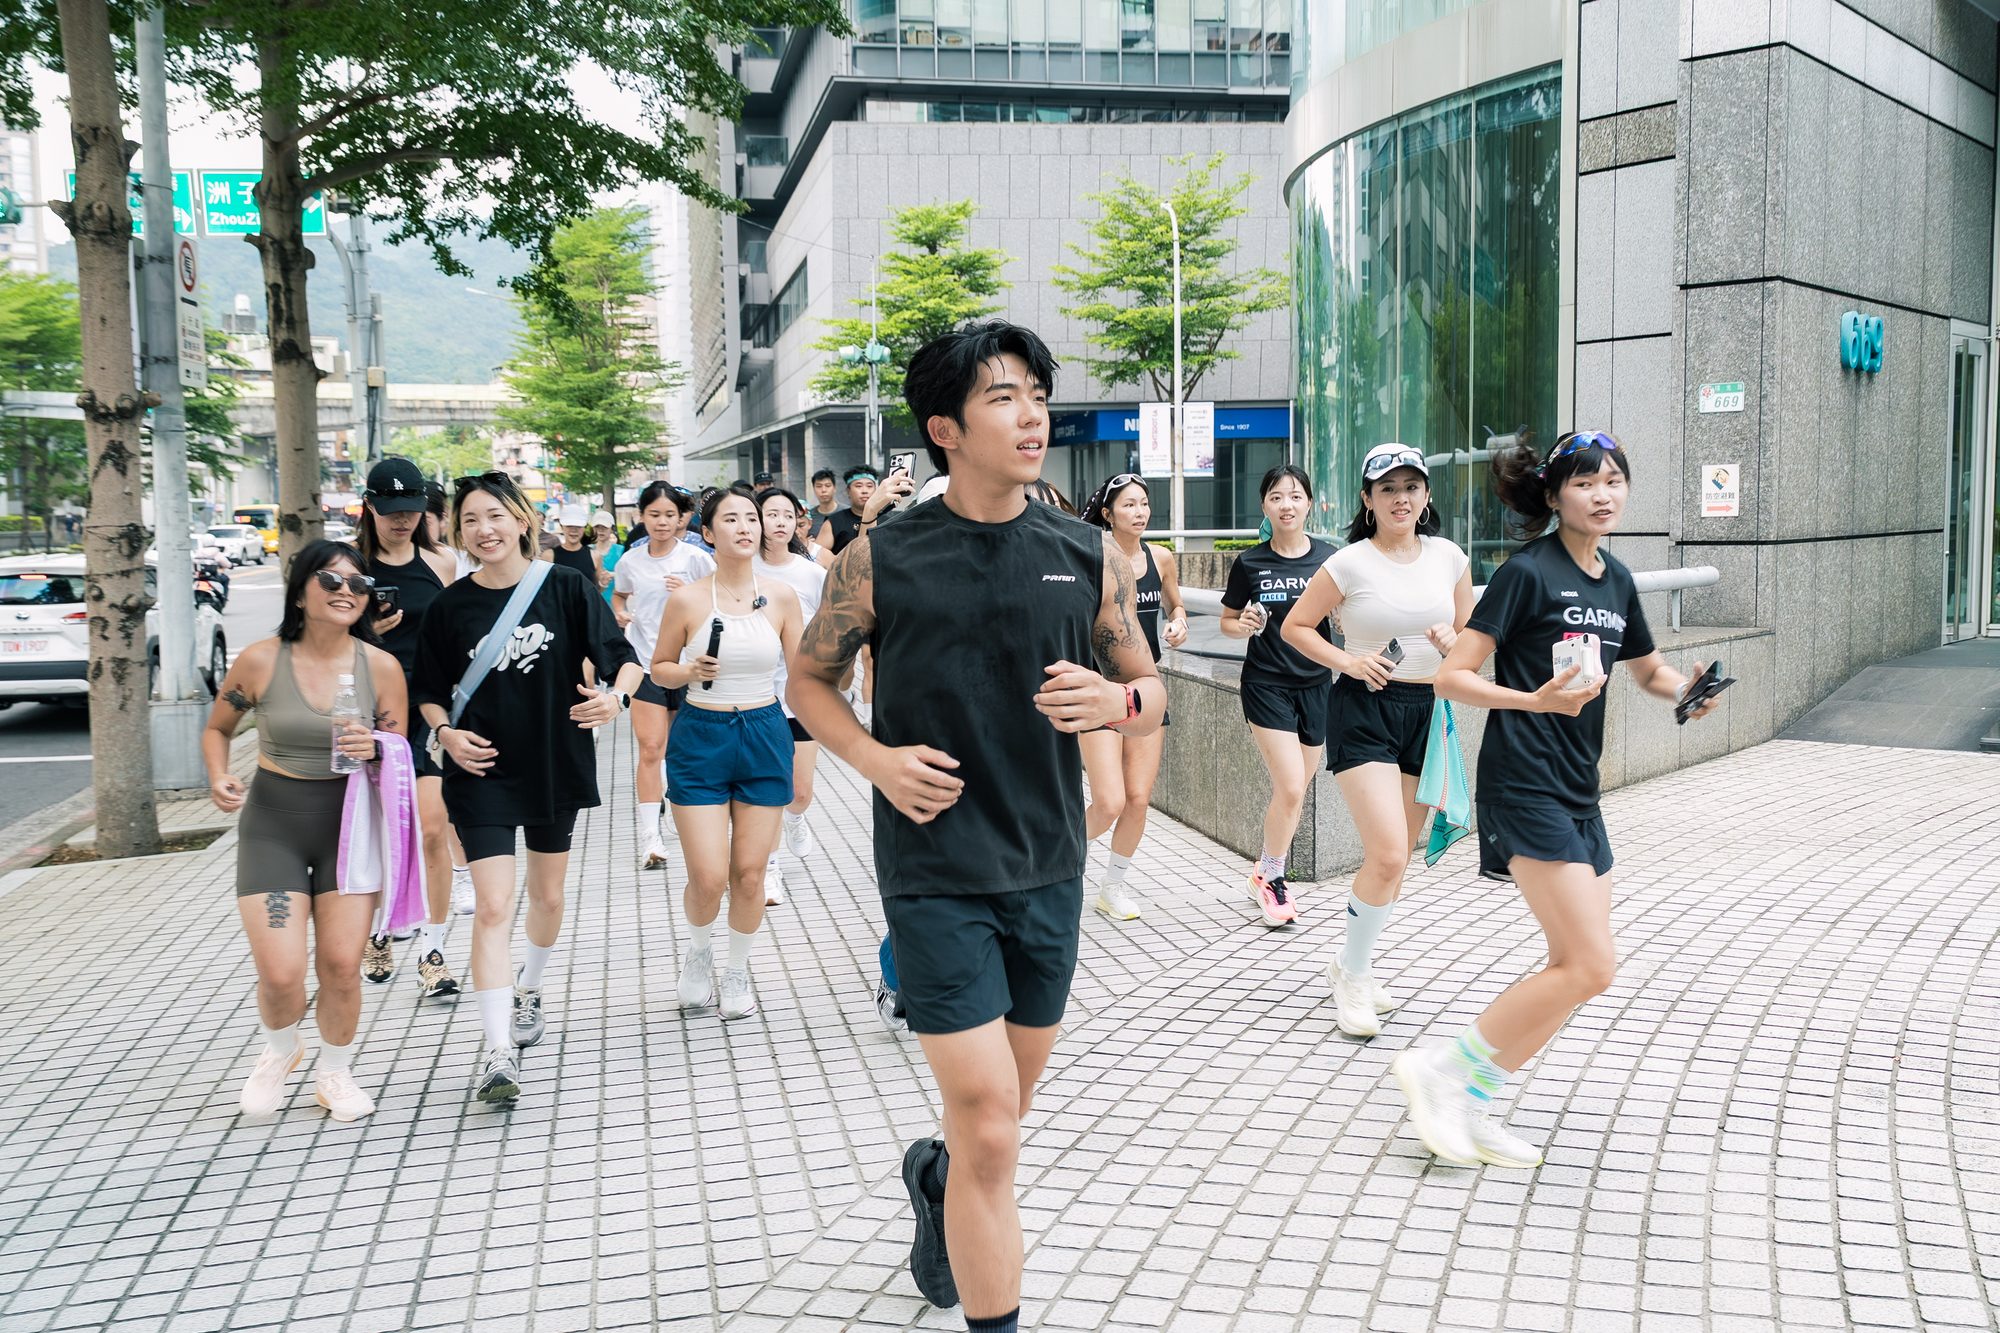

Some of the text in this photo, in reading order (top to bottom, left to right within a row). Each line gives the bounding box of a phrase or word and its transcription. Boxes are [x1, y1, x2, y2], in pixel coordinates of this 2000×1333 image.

[1842, 310, 1883, 372] 669
[1714, 396, 1739, 407] 669
[1260, 577, 1312, 590] GARM
